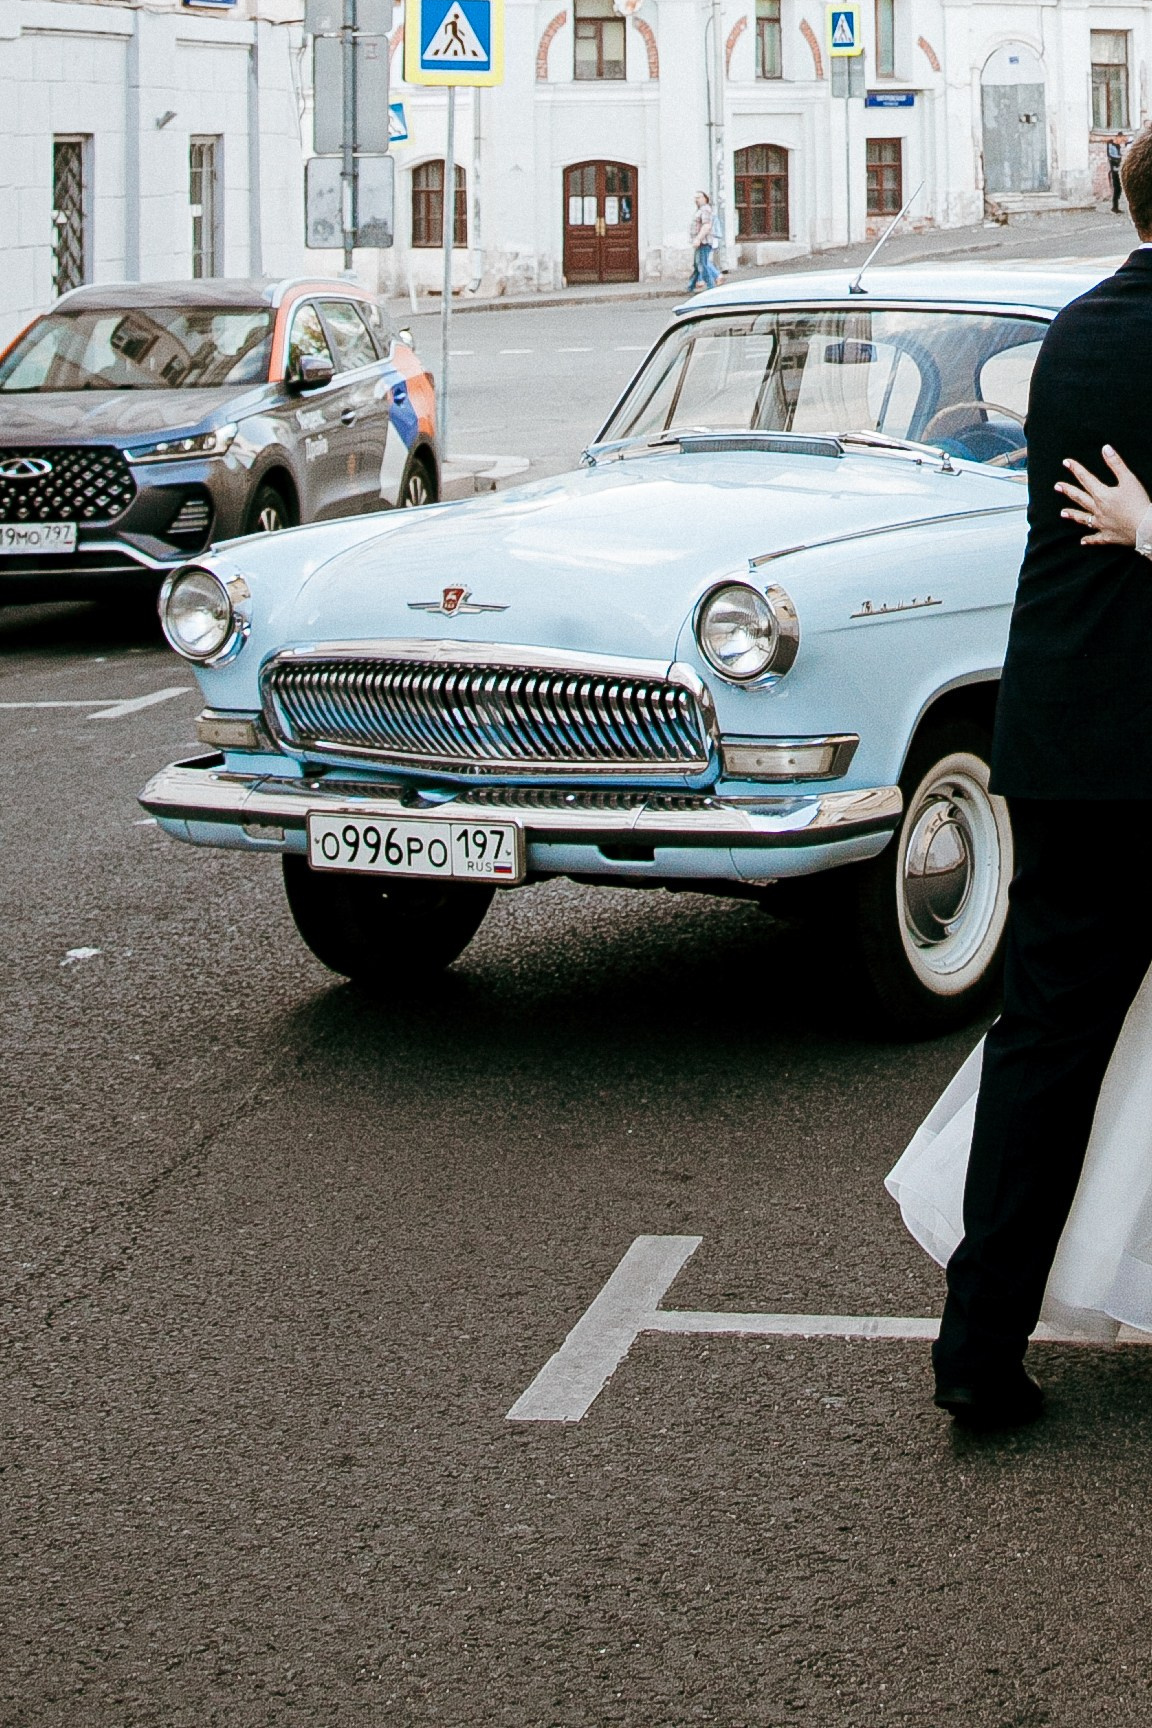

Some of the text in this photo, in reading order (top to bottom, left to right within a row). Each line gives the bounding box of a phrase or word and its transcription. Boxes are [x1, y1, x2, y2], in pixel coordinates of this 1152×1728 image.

[43, 525, 71, 540] 797
[321, 824, 505, 868] О996РО 197
[467, 860, 492, 872] RUS
